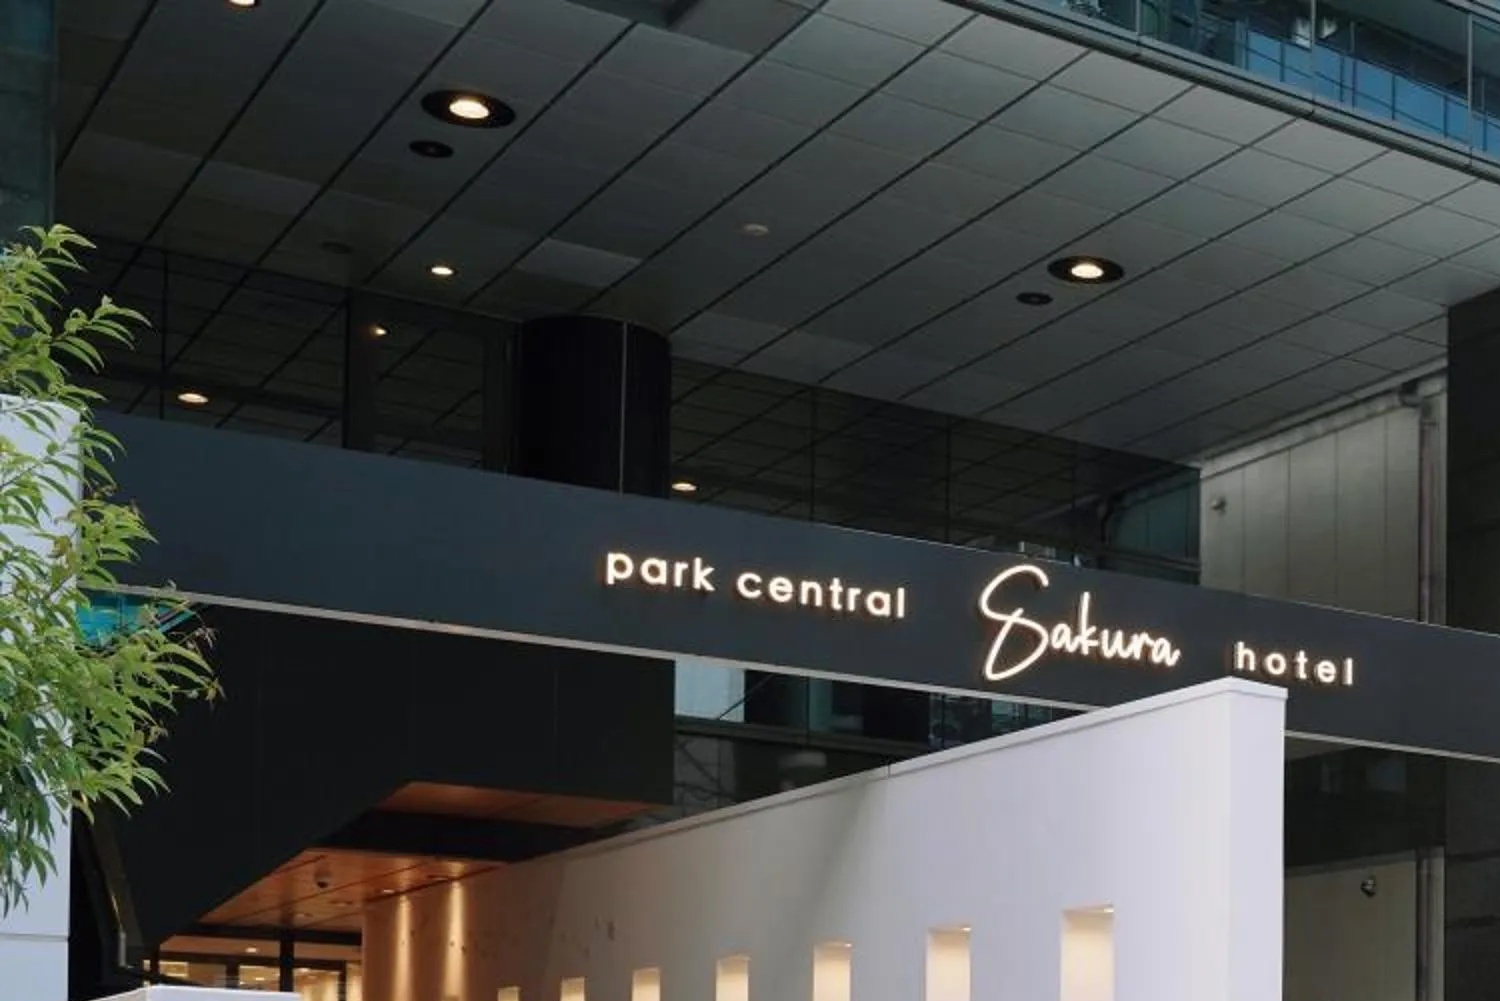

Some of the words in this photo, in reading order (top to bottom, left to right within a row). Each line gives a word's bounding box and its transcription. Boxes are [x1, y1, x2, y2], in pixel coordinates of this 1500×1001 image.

[605, 551, 716, 592] park
[736, 571, 906, 619] central
[978, 563, 1182, 682] Sakura
[1233, 640, 1354, 685] hotel
